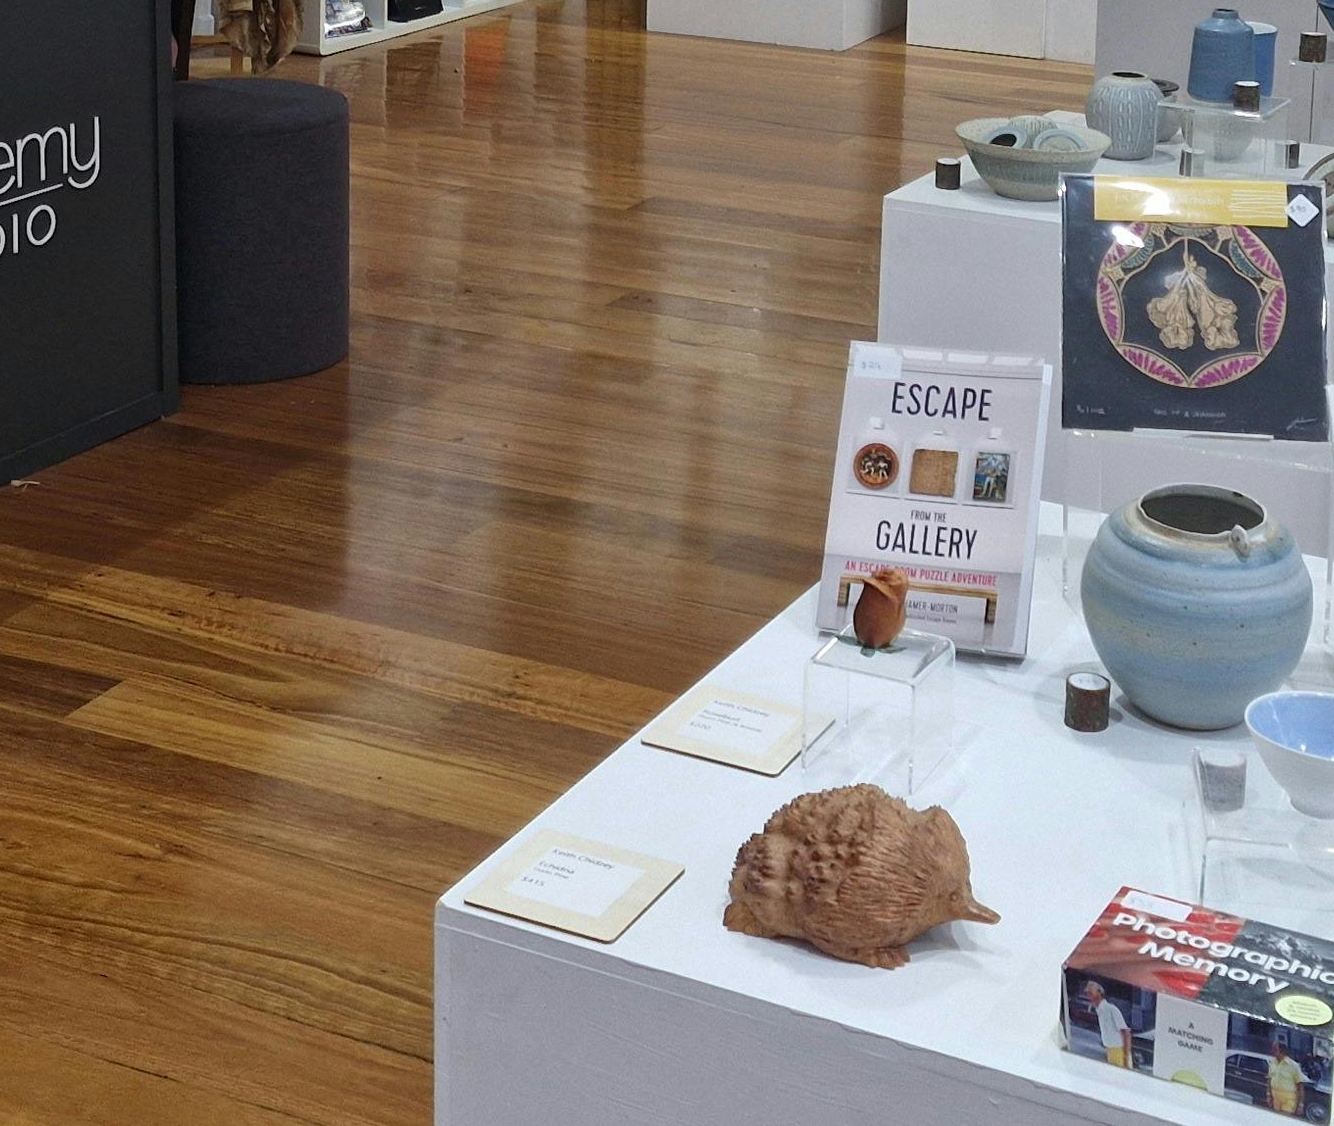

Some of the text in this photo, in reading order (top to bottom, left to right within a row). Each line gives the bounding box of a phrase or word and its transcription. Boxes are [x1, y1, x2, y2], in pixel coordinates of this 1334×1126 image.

[891, 381, 993, 422] ESCAPE
[910, 509, 947, 524] FROM THE
[875, 519, 978, 560] GALLERY
[845, 560, 857, 572] AN
[920, 568, 949, 582] PUZZLE
[951, 571, 998, 587] ADVENTURE
[538, 860, 575, 875] Echidna
[1137, 941, 1291, 995] Memory
[1168, 1026, 1214, 1046] MATCHING
[1188, 1022, 1195, 1030] A
[1177, 1040, 1204, 1053] GAME
